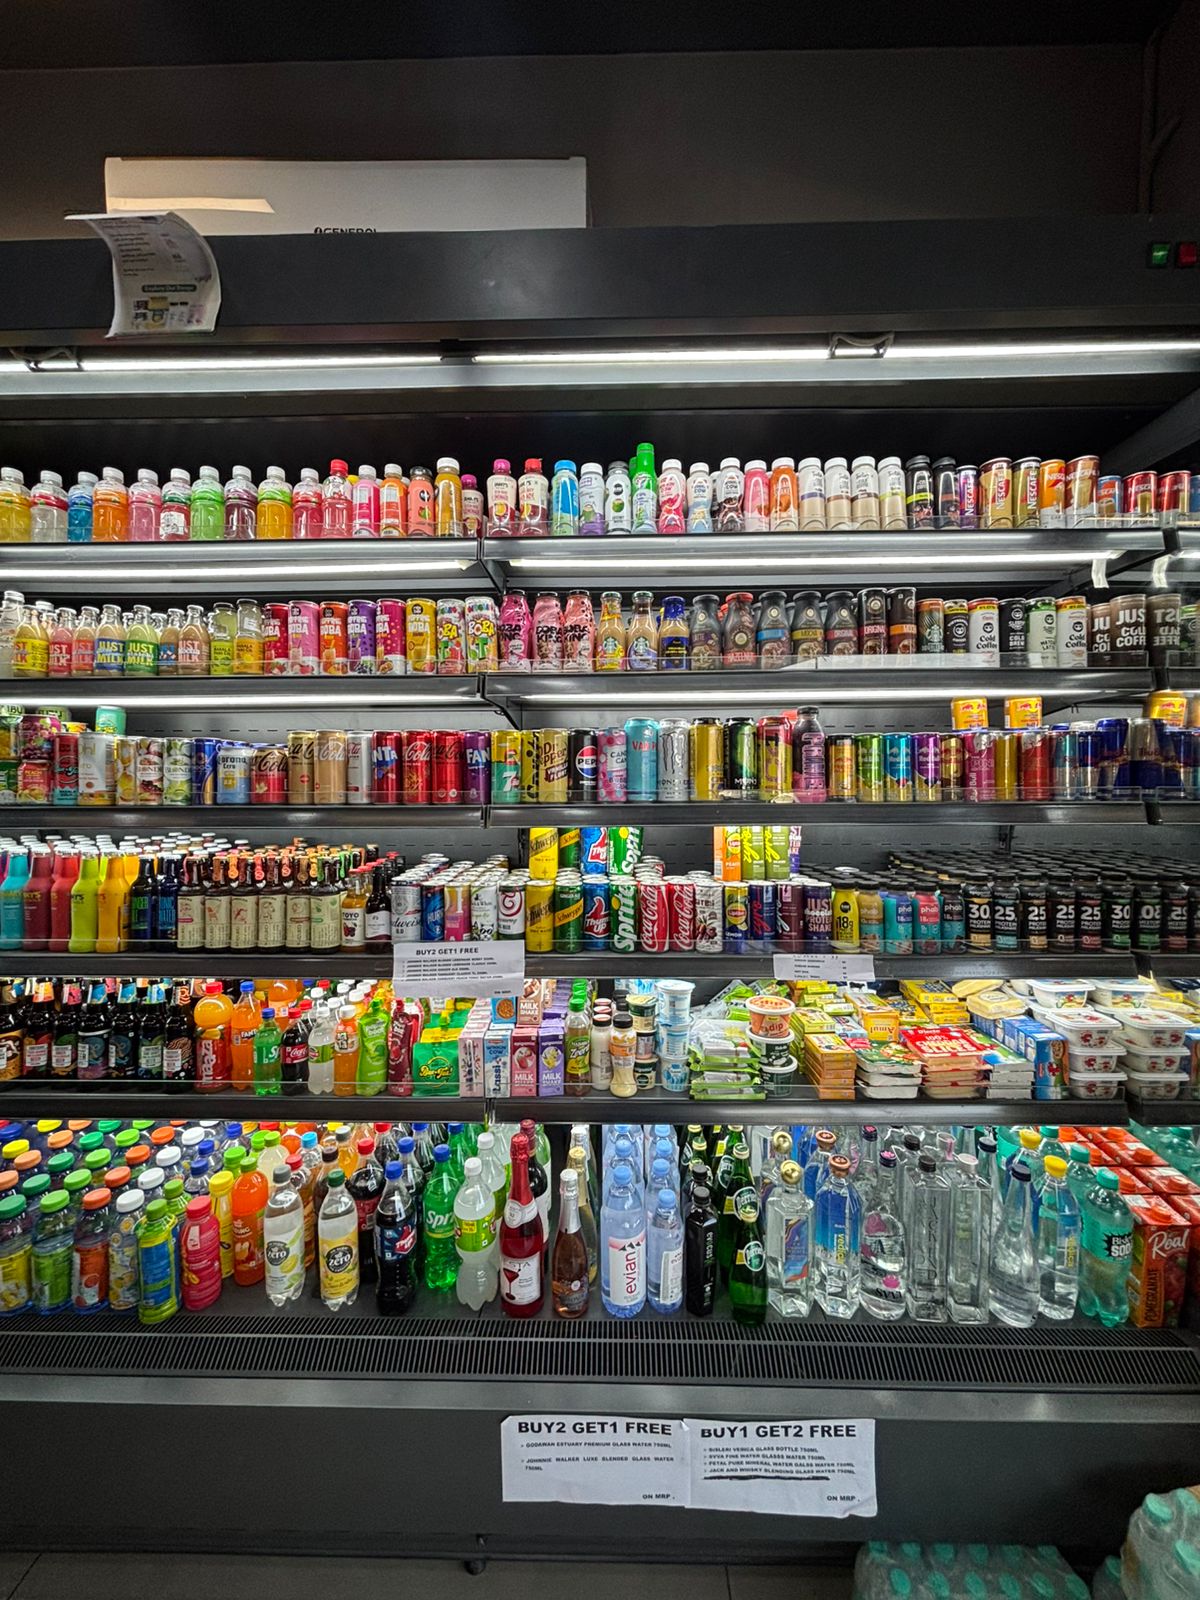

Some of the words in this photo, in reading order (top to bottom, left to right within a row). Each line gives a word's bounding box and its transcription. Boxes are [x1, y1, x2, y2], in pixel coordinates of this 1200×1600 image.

[468, 620, 496, 636] BOBA
[128, 643, 154, 653] JUST
[613, 886, 636, 952] Sprite
[1028, 906, 1047, 921] 25
[1056, 905, 1075, 919] 25
[1081, 906, 1101, 920] 25
[520, 1002, 539, 1010] MILK
[624, 1250, 638, 1295] evian
[518, 1422, 566, 1434] BUY2
[572, 1422, 618, 1434] GET1
[626, 1422, 672, 1435] FREE
[701, 1426, 748, 1438] BUY1
[756, 1425, 803, 1438] GET2
[810, 1425, 856, 1438] FREE
